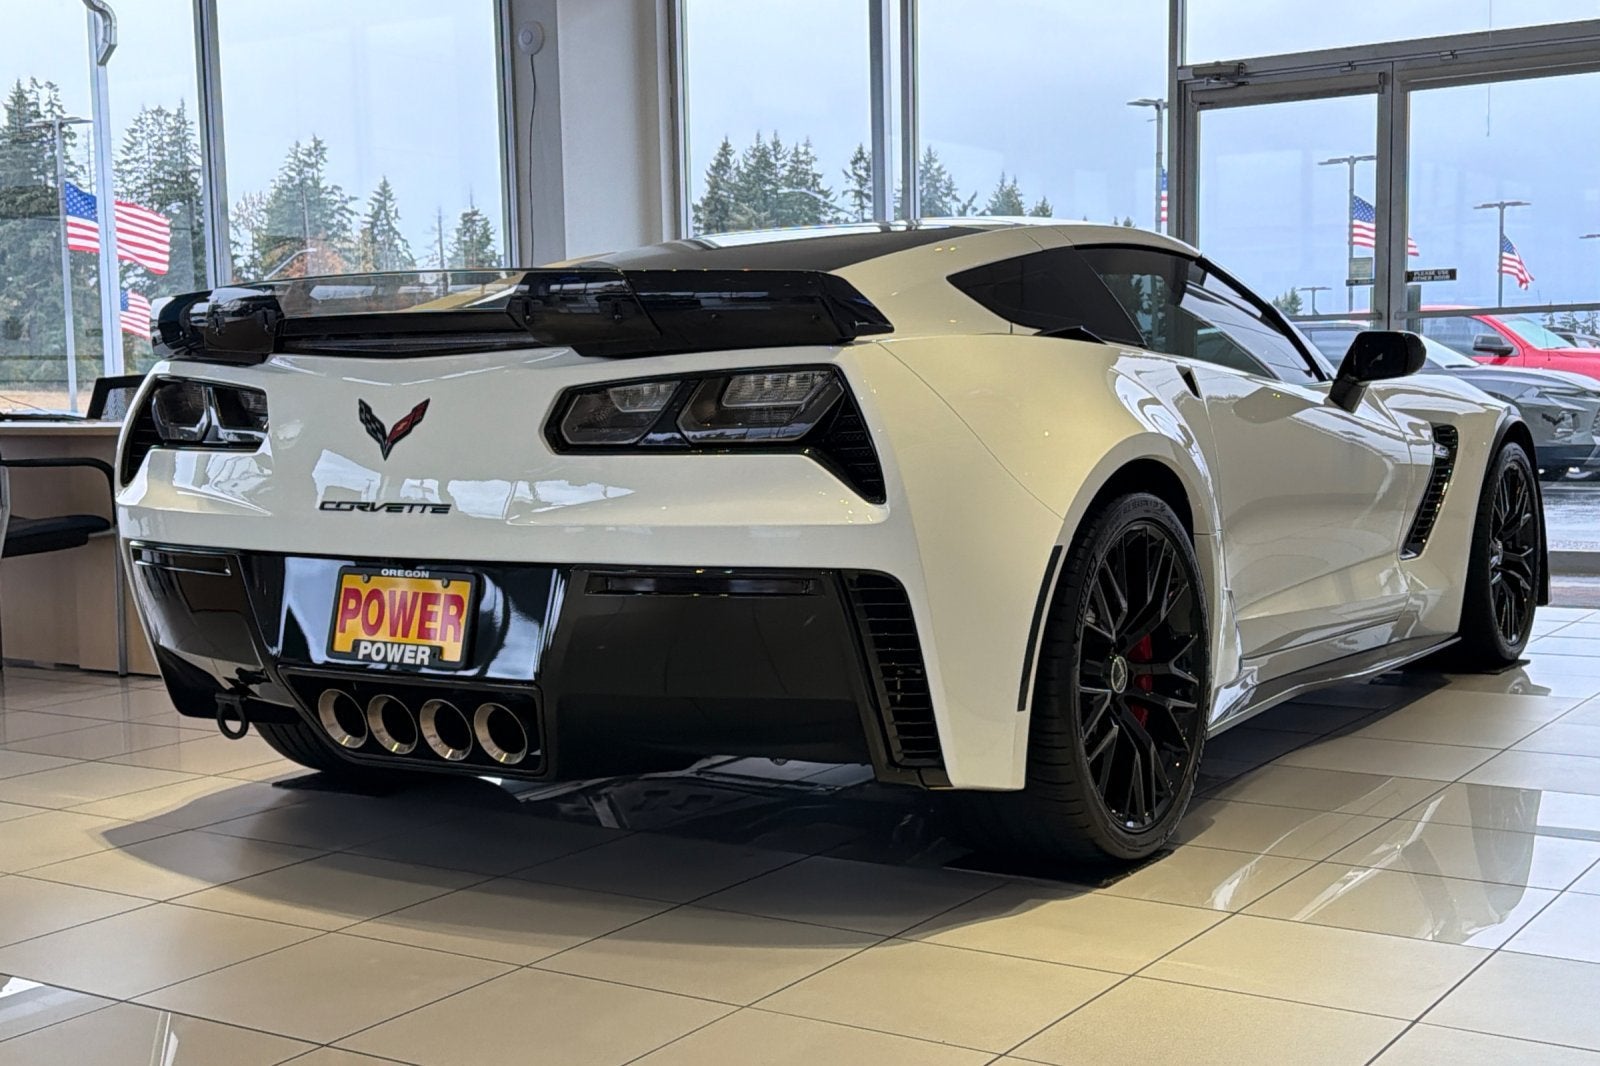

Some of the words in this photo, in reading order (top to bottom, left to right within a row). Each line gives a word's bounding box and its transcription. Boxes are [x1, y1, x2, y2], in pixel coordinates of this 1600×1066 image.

[319, 501, 452, 514] CORVETTE
[381, 568, 430, 578] OREGON
[338, 587, 465, 643] POWER
[357, 641, 431, 665] POWER
